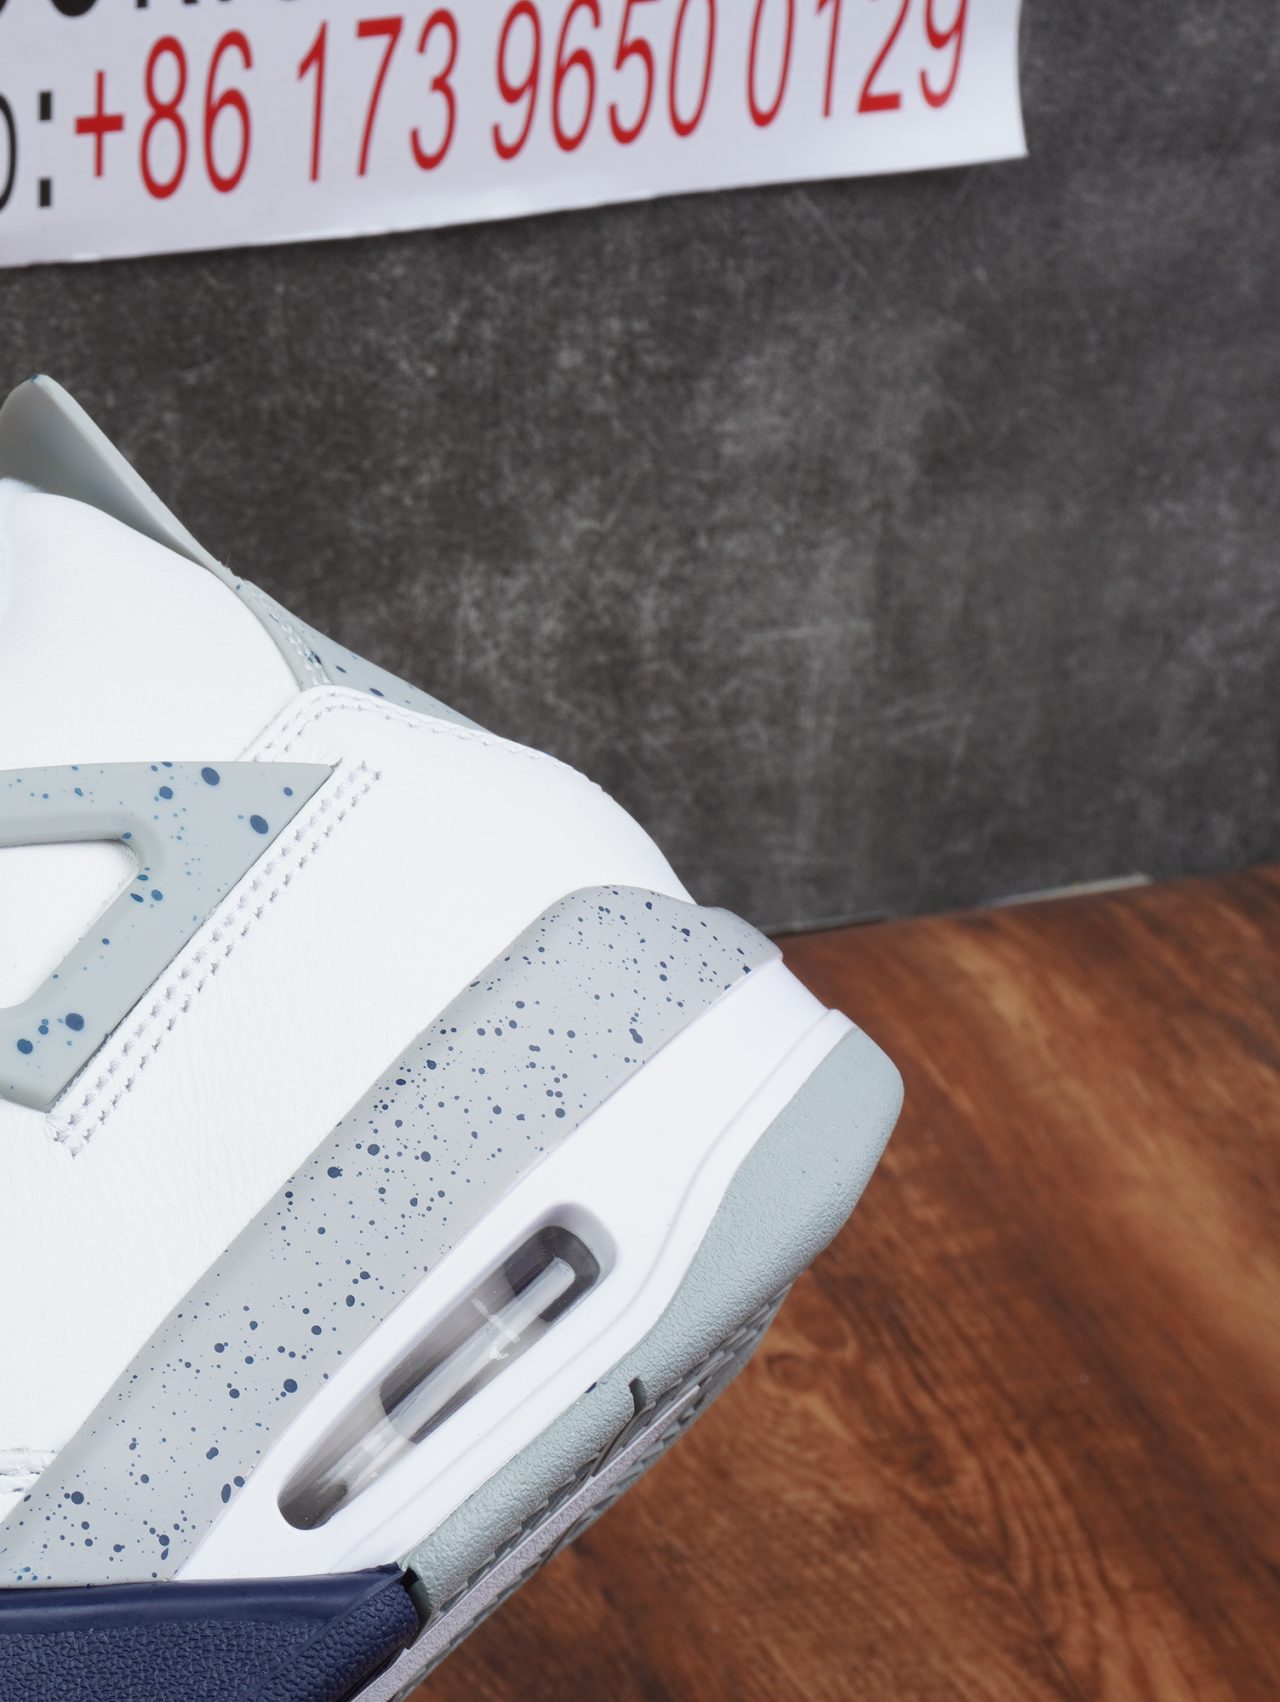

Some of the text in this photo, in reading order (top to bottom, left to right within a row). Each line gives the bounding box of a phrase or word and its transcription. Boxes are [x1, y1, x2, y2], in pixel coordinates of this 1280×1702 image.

[297, 7, 460, 182] 173
[491, 0, 717, 162] 9650
[746, 0, 970, 129] 0129
